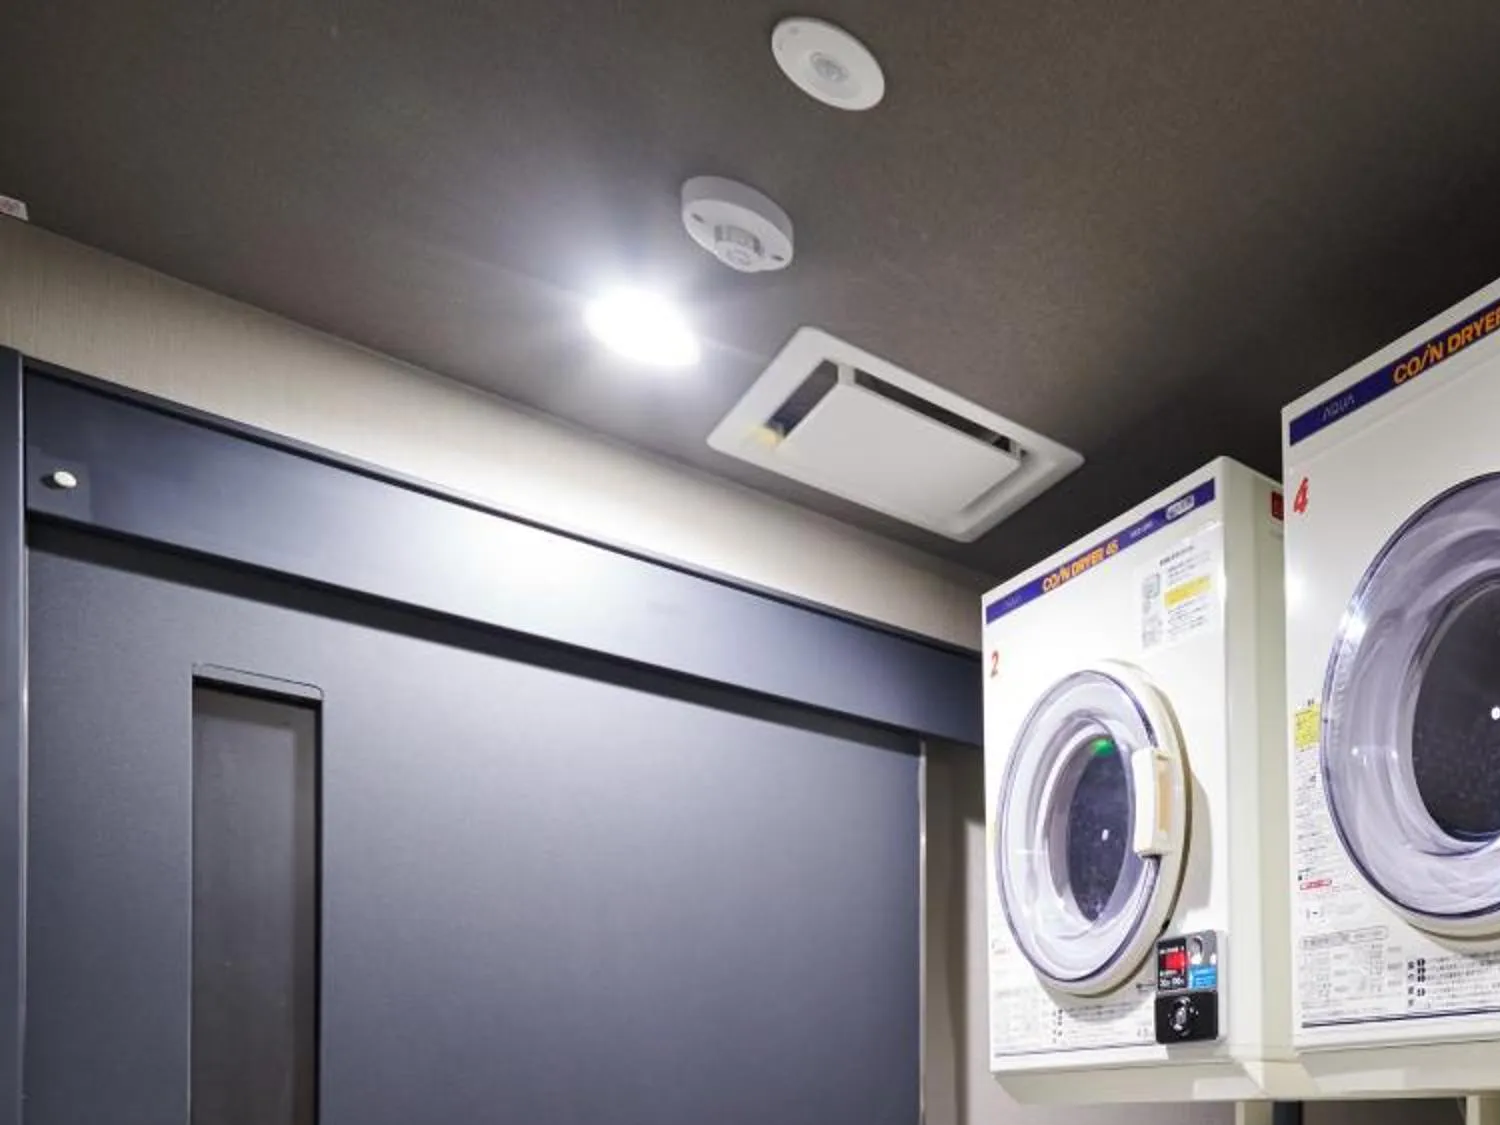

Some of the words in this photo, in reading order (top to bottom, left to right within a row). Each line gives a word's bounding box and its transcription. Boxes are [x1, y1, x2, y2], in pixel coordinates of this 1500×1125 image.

[1393, 342, 1444, 385] COIN
[1293, 477, 1309, 513] 4
[990, 650, 999, 679] 2
